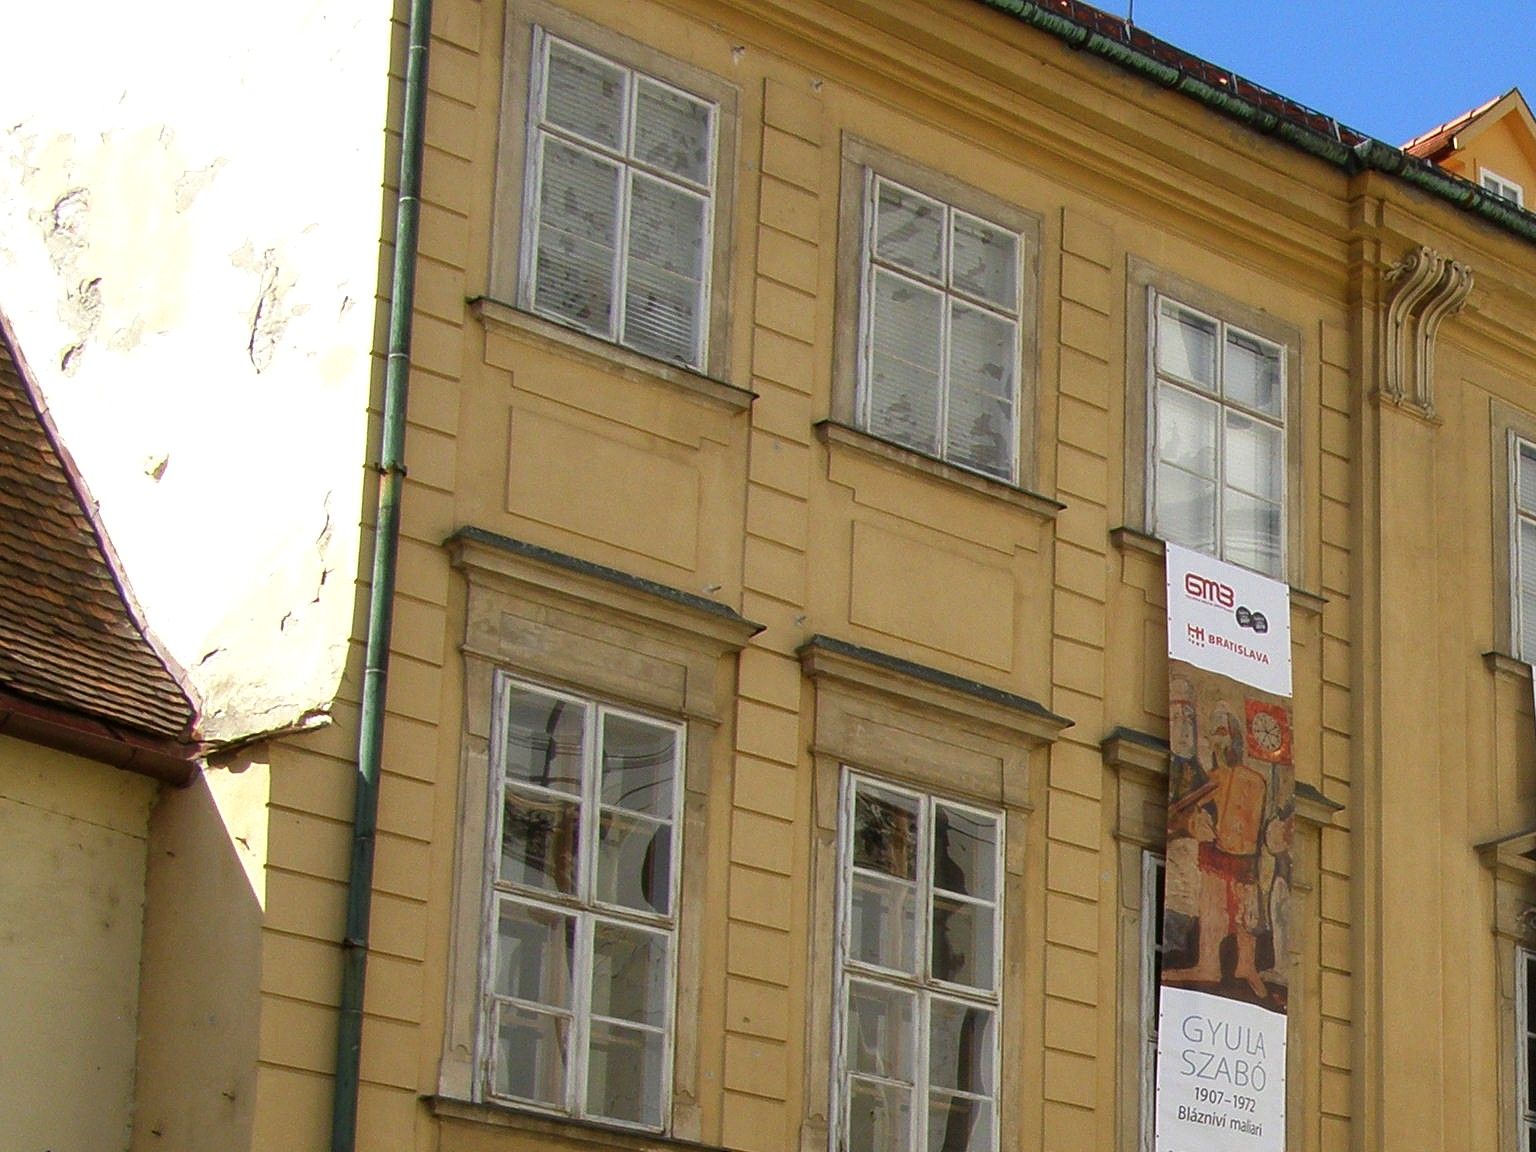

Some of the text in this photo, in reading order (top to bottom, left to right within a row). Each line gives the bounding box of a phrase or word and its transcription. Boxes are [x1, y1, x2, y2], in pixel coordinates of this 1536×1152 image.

[1185, 573, 1234, 608] GMB
[1208, 634, 1269, 664] BRATISLAVA
[1182, 1015, 1266, 1059] GYULA
[1180, 1049, 1266, 1092] SZABÓ
[1230, 1117, 1263, 1137] maliari
